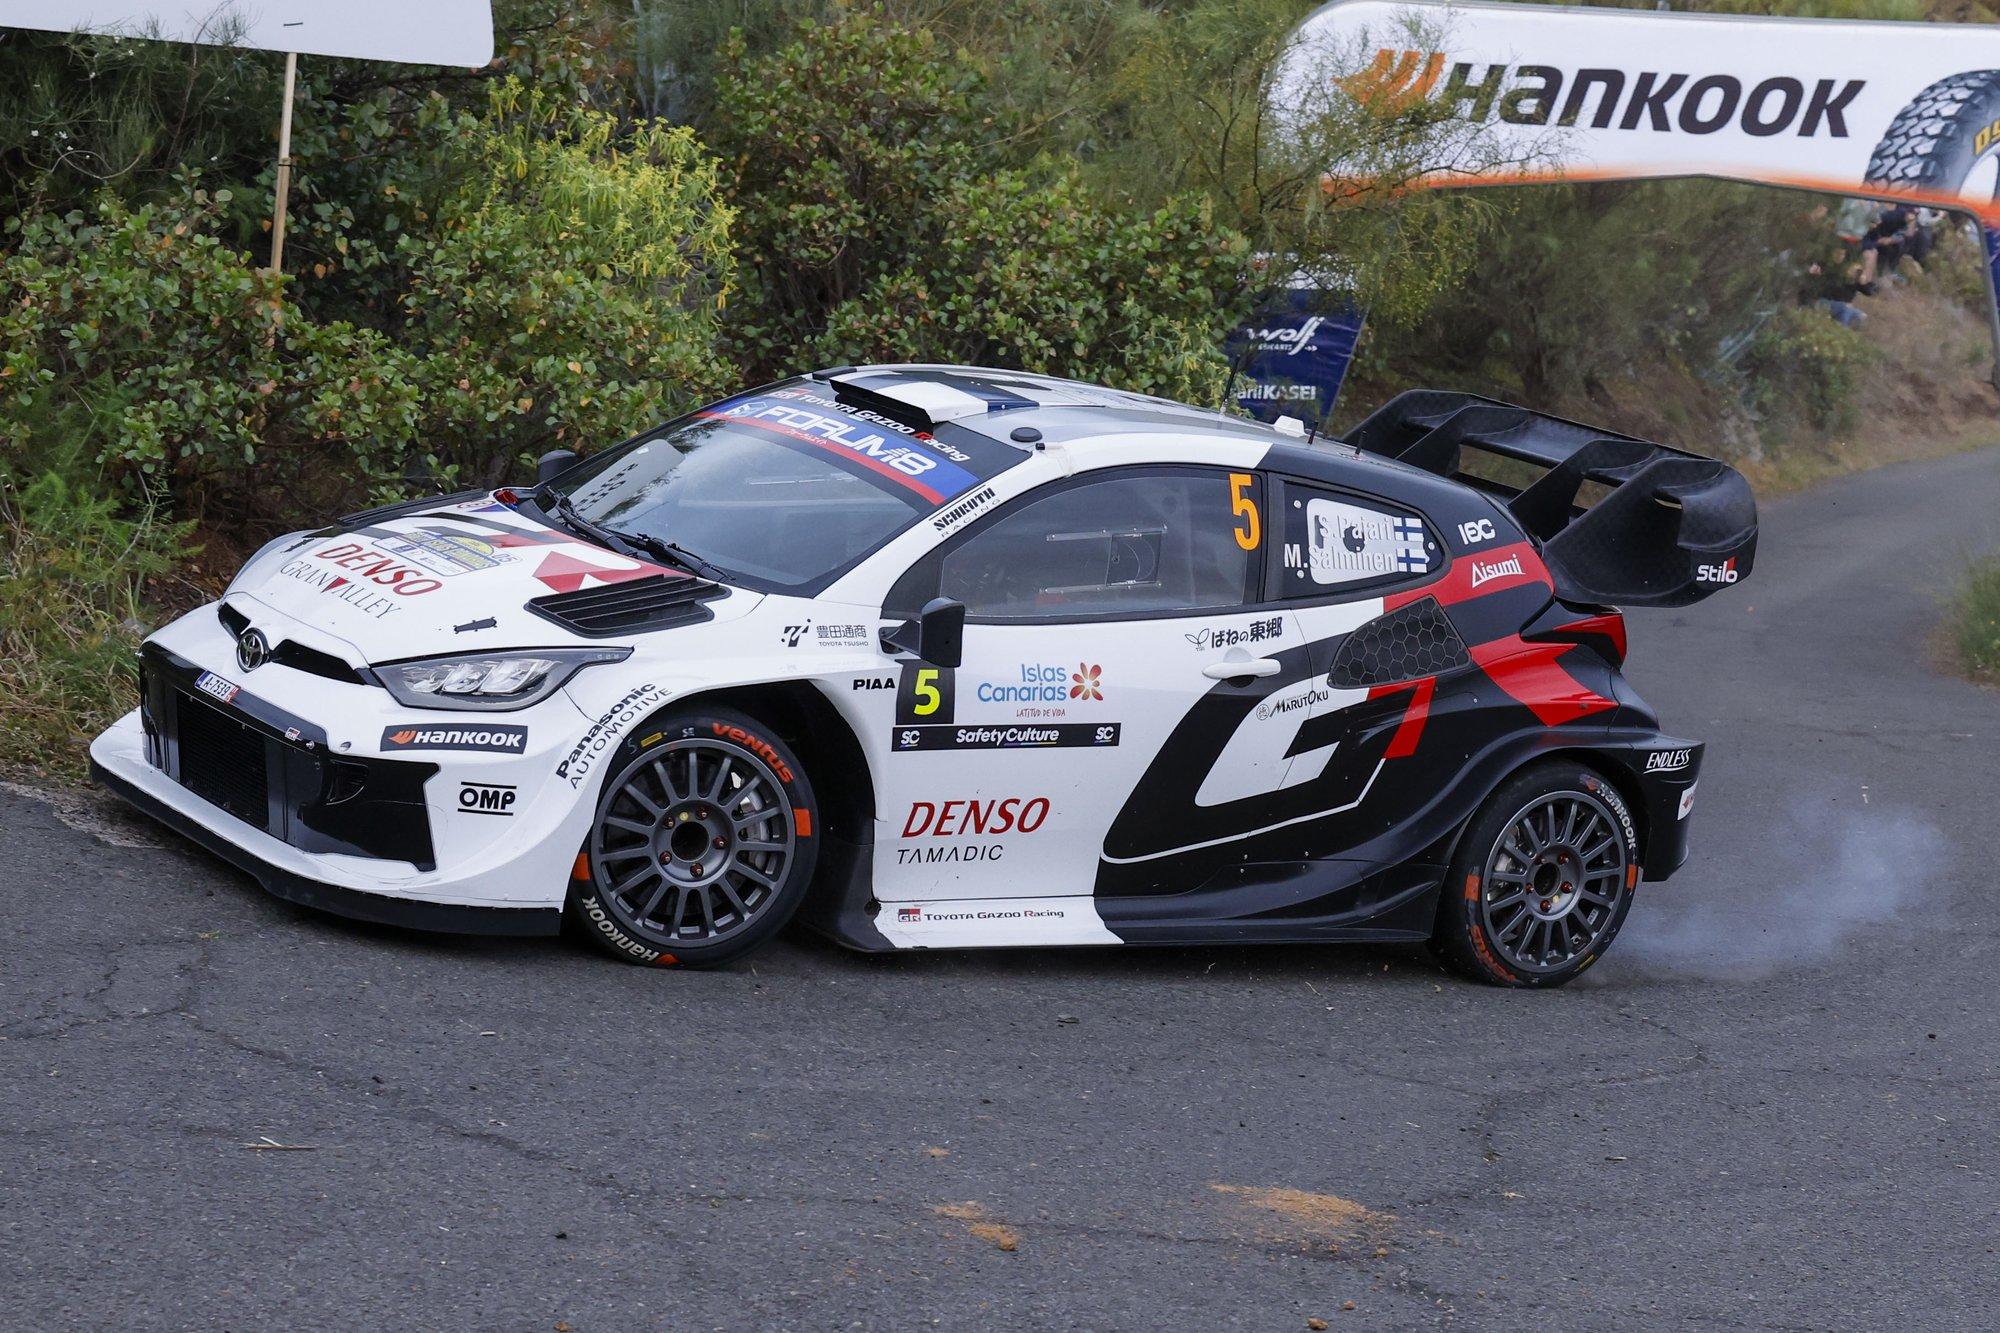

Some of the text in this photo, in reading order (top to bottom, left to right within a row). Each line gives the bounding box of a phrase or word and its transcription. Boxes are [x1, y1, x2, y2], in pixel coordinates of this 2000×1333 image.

[854, 410, 916, 435] GAZOO
[913, 431, 971, 462] Racing
[933, 487, 996, 531] SCHROTH
[941, 498, 1001, 538] RACING
[1230, 474, 1261, 551] 5
[314, 543, 443, 596] DENSO
[1471, 554, 1526, 589] Aisumi
[1696, 560, 1738, 583] Stilo
[1211, 616, 1283, 649] ばねの東郷
[852, 677, 896, 691] PIAA
[1021, 663, 1067, 683] Islas
[913, 669, 941, 716] 5
[977, 682, 1067, 703] Canarias
[1016, 707, 1066, 718] LATITUD DE VIDA
[555, 683, 657, 780] Panasonic
[569, 687, 674, 790] AUTOMOTIVE
[900, 726, 1114, 747] SC SafetyCulture SC
[1646, 748, 1692, 769] ENDLESS
[459, 787, 516, 811] OMP
[901, 797, 1051, 838] DENSO
[924, 913, 974, 921] TOYOTA
[977, 911, 1021, 919] GAZOO
[1024, 909, 1065, 918] Racing
